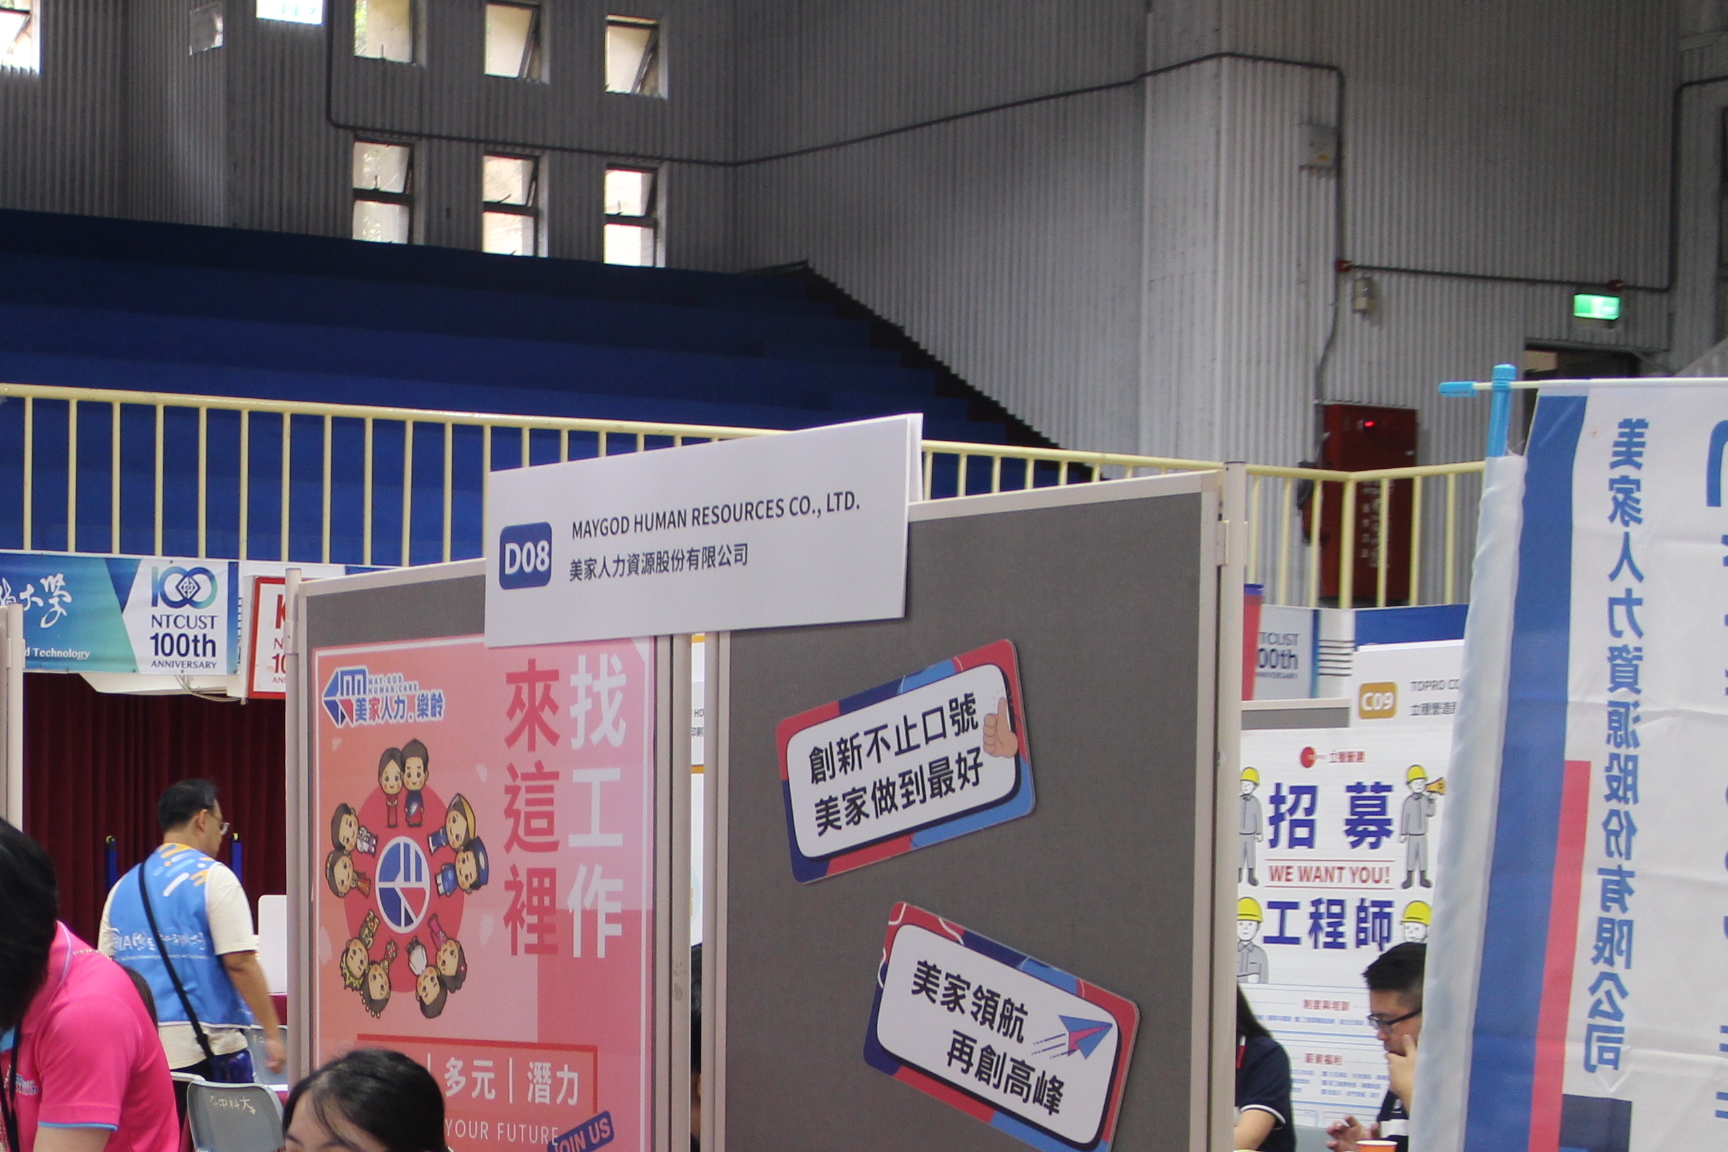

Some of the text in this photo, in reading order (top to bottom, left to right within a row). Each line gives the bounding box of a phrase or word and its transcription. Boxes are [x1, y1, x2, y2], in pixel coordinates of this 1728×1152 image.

[572, 490, 861, 540] MAYGOD HUMAN RESOURCES CO., LTD.
[503, 540, 550, 575] D08
[569, 542, 749, 583] 美家人力資源股份有限公司
[151, 614, 216, 629] NTCUST
[1257, 632, 1300, 646] TCUST
[33, 647, 91, 660] Technology
[149, 633, 217, 658] 100th
[151, 659, 217, 670] ANNIVERSARY
[1257, 648, 1298, 669] 00th
[1361, 692, 1395, 710] C09
[809, 691, 979, 785] 創新不止口號
[503, 658, 560, 956] 來這裡
[568, 653, 627, 959] 找工作
[814, 746, 985, 837] 美家做到最好
[1268, 781, 1394, 850] 招募
[1269, 865, 1391, 885] WE WANT YOU!
[1263, 897, 1394, 951] 工程師
[910, 959, 1029, 1045] 美家領航
[527, 1061, 578, 1105] 潛力
[946, 1028, 1064, 1117] 再創高峰
[445, 1118, 559, 1146] YOUR FUTURE
[588, 1117, 610, 1145] US
